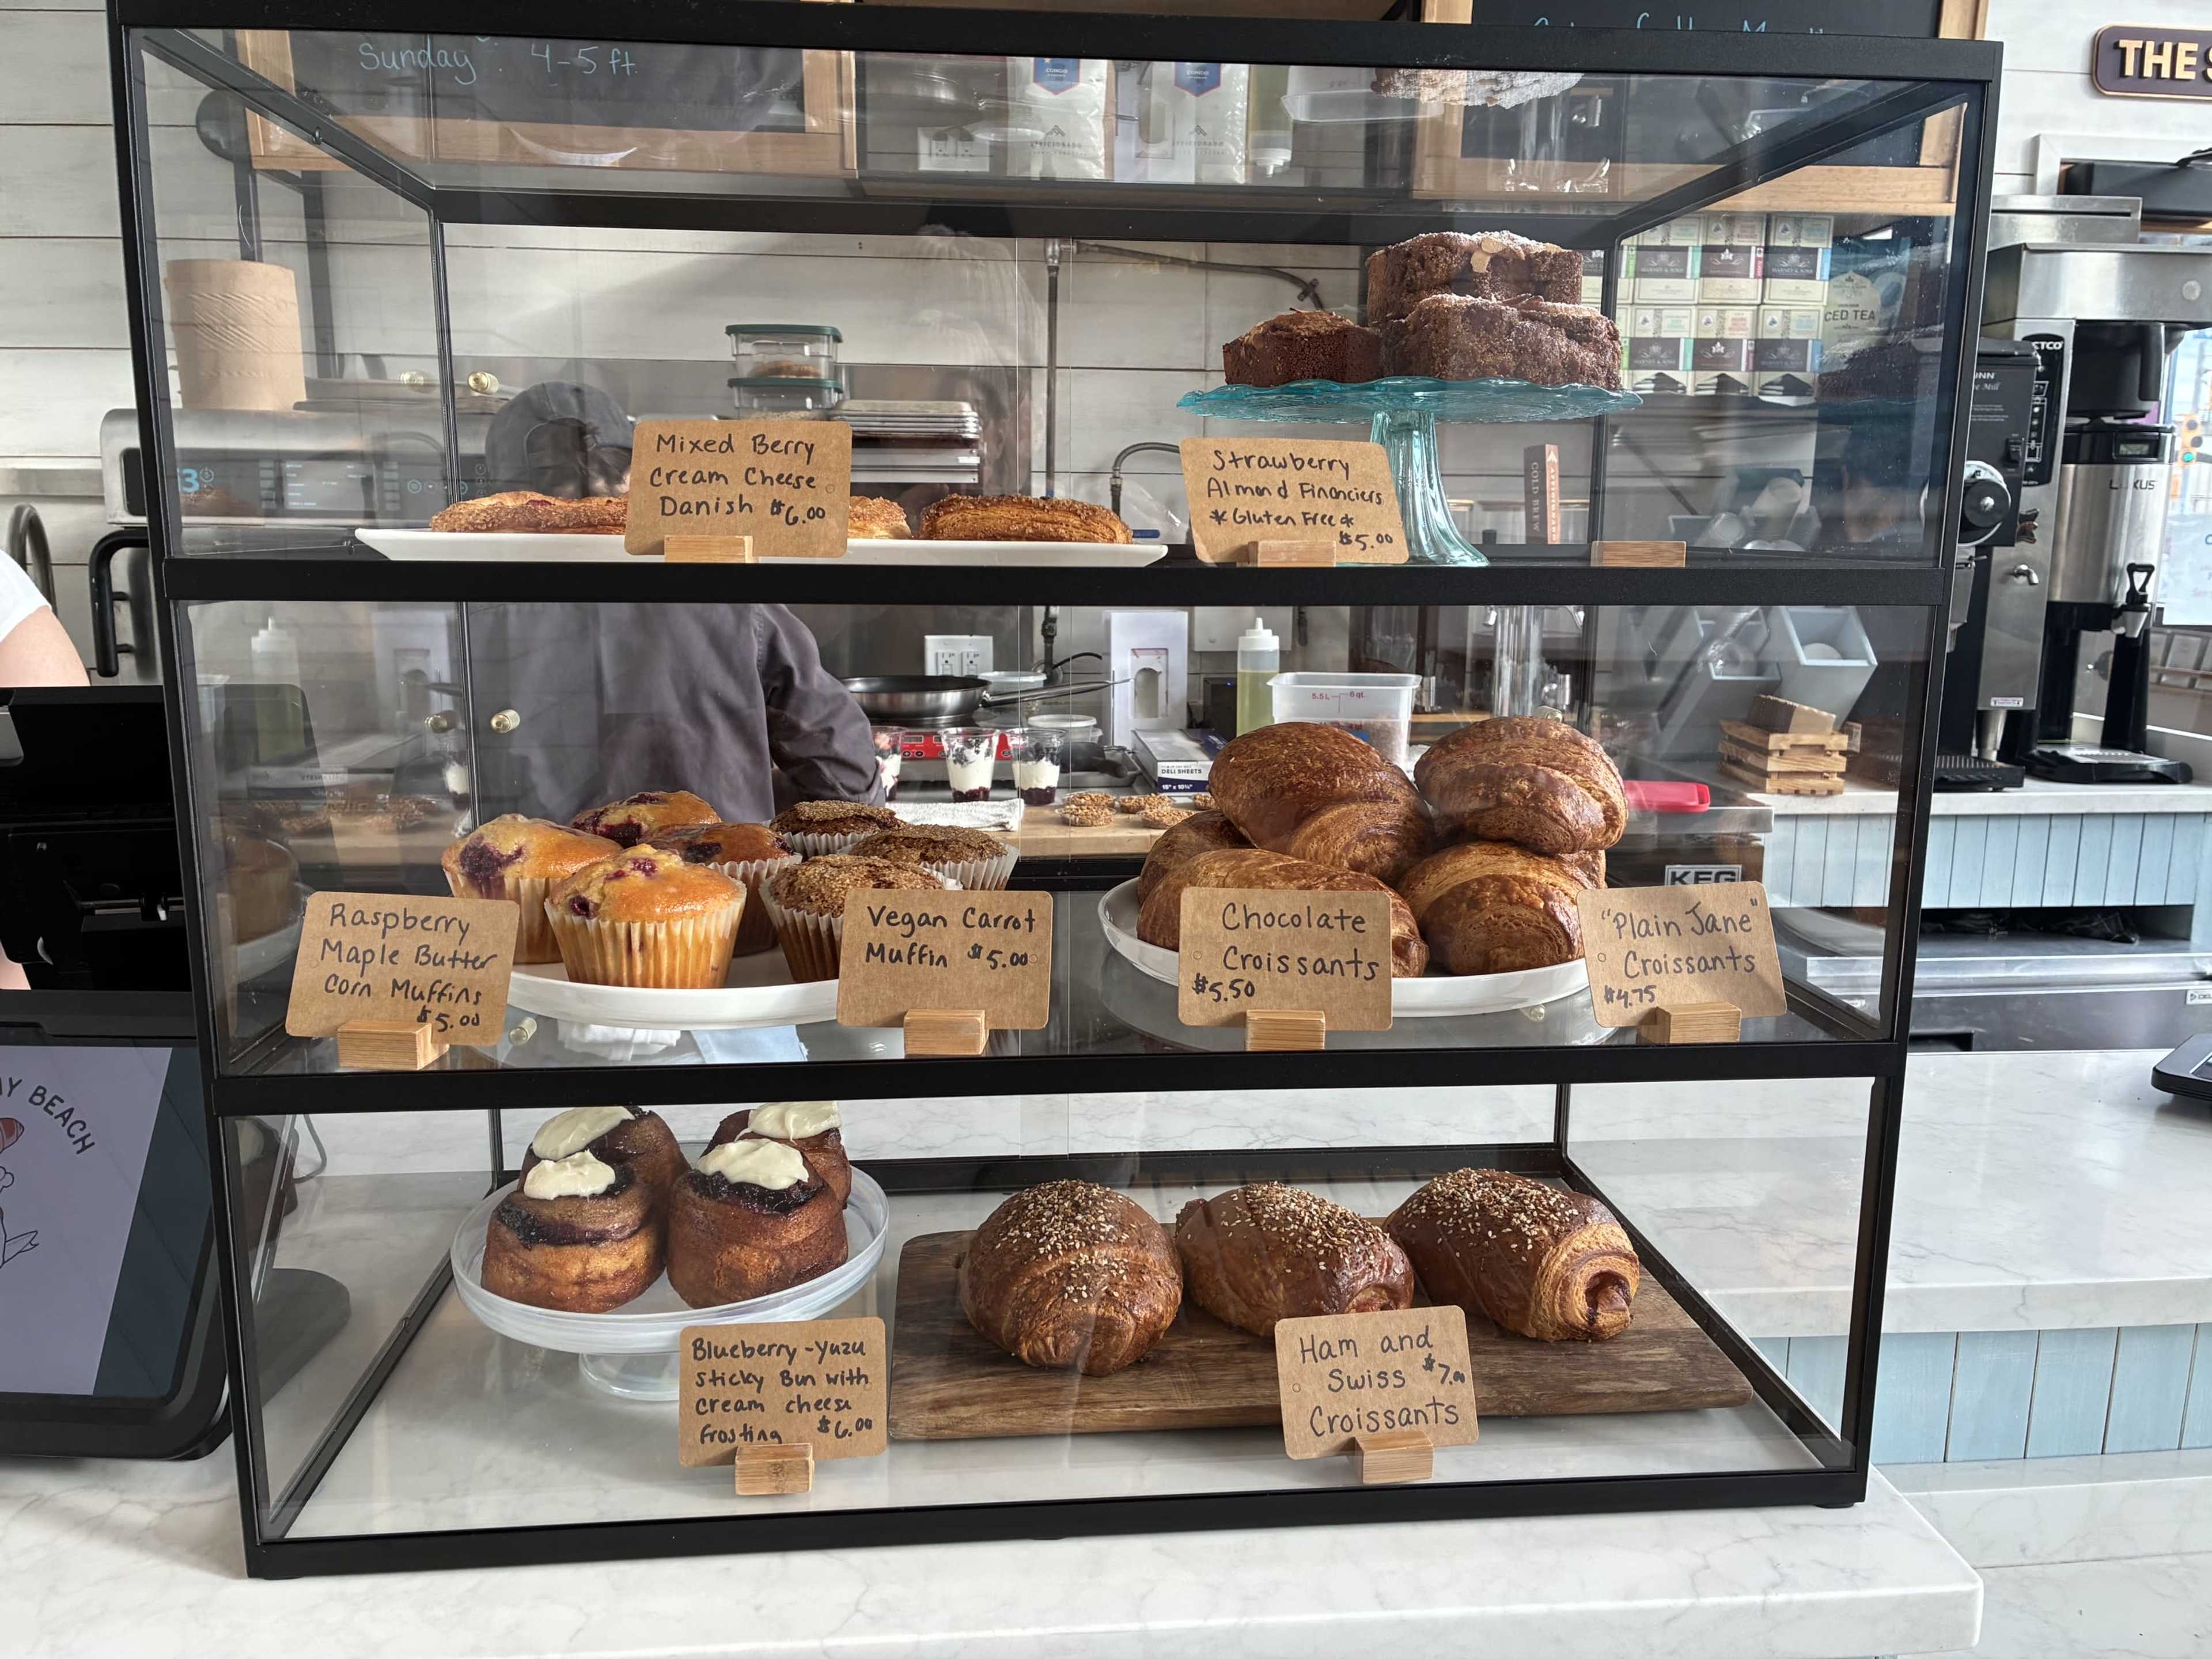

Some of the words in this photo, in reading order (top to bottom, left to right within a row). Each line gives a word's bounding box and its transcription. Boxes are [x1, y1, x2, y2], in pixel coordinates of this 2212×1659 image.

[359, 35, 477, 85] Sunday
[2118, 39, 2198, 79] THE
[1824, 310, 1849, 321] CED
[1852, 309, 1875, 320] TEA
[2032, 341, 2063, 350] ETCO
[1975, 372, 1995, 380] NN
[656, 433, 734, 453] Mixed
[751, 433, 815, 465] Berry
[1212, 449, 1350, 481] Strawberry
[650, 467, 729, 487] Cream
[744, 466, 816, 489] Cheese
[1207, 476, 1289, 499] Almond
[1531, 462, 1539, 494] COLD
[2109, 479, 2156, 490] LXUS
[660, 494, 753, 517] Danish
[770, 498, 826, 526] $6.00
[1339, 531, 1393, 551] $5.00
[330, 903, 469, 946] Raspberry
[866, 905, 948, 938] Vegan
[963, 906, 1036, 933] Carrot
[1222, 902, 1366, 933] Chocolate
[320, 938, 400, 978] Maple
[415, 944, 498, 971] Butter
[865, 942, 948, 968] Muffin
[1223, 945, 1380, 981] Croissants
[1624, 945, 1756, 979] Croissants
[324, 973, 372, 998] Corn
[391, 978, 482, 1005] Muffins
[1192, 972, 1256, 1003] $5.50
[1604, 984, 1657, 1009] $4.75
[28, 1085, 96, 1154] BEACH
[1299, 1334, 1358, 1364] Ham
[1380, 1325, 1433, 1354] and
[779, 1369, 816, 1387] Bun
[826, 1367, 869, 1385] with
[1327, 1368, 1406, 1393] Swiss
[1310, 1396, 1460, 1437] Croissants
